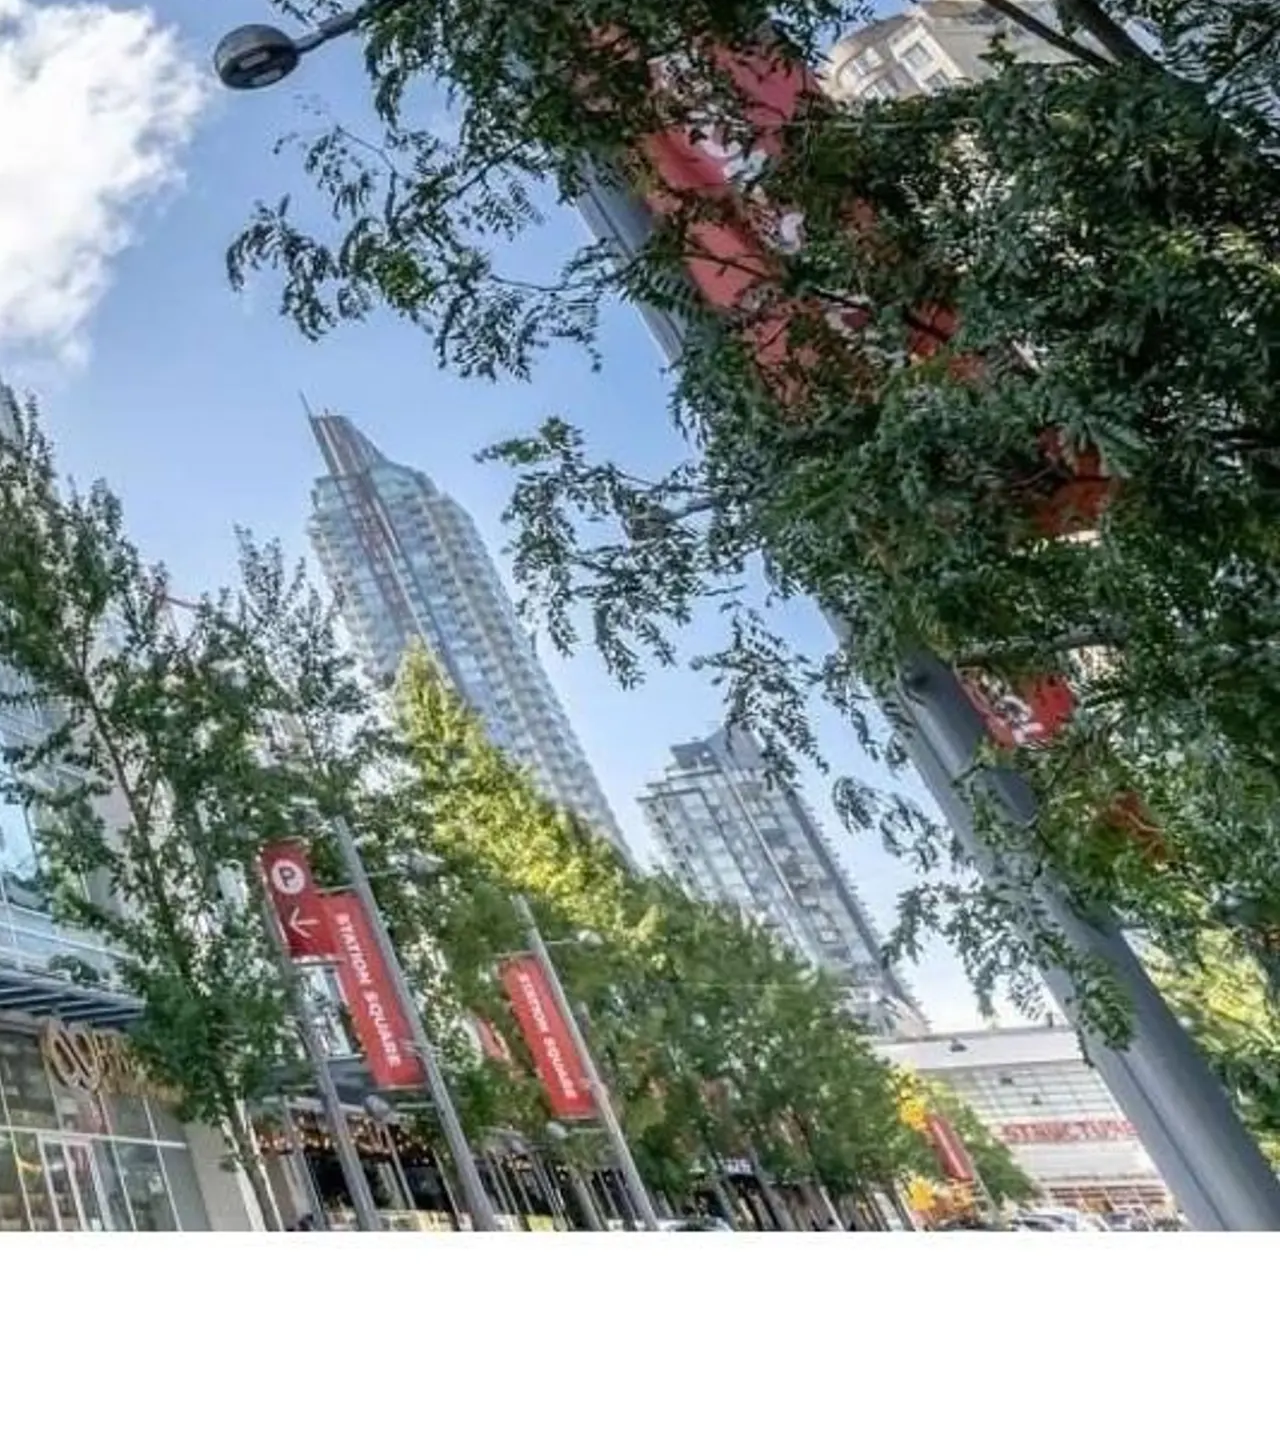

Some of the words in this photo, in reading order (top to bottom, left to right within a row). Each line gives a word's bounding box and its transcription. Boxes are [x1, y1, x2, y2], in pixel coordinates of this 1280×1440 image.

[335, 912, 373, 985] STATION
[363, 990, 402, 1067] SQUARE
[516, 972, 550, 1033] STATION
[543, 1036, 579, 1099] SQUARE
